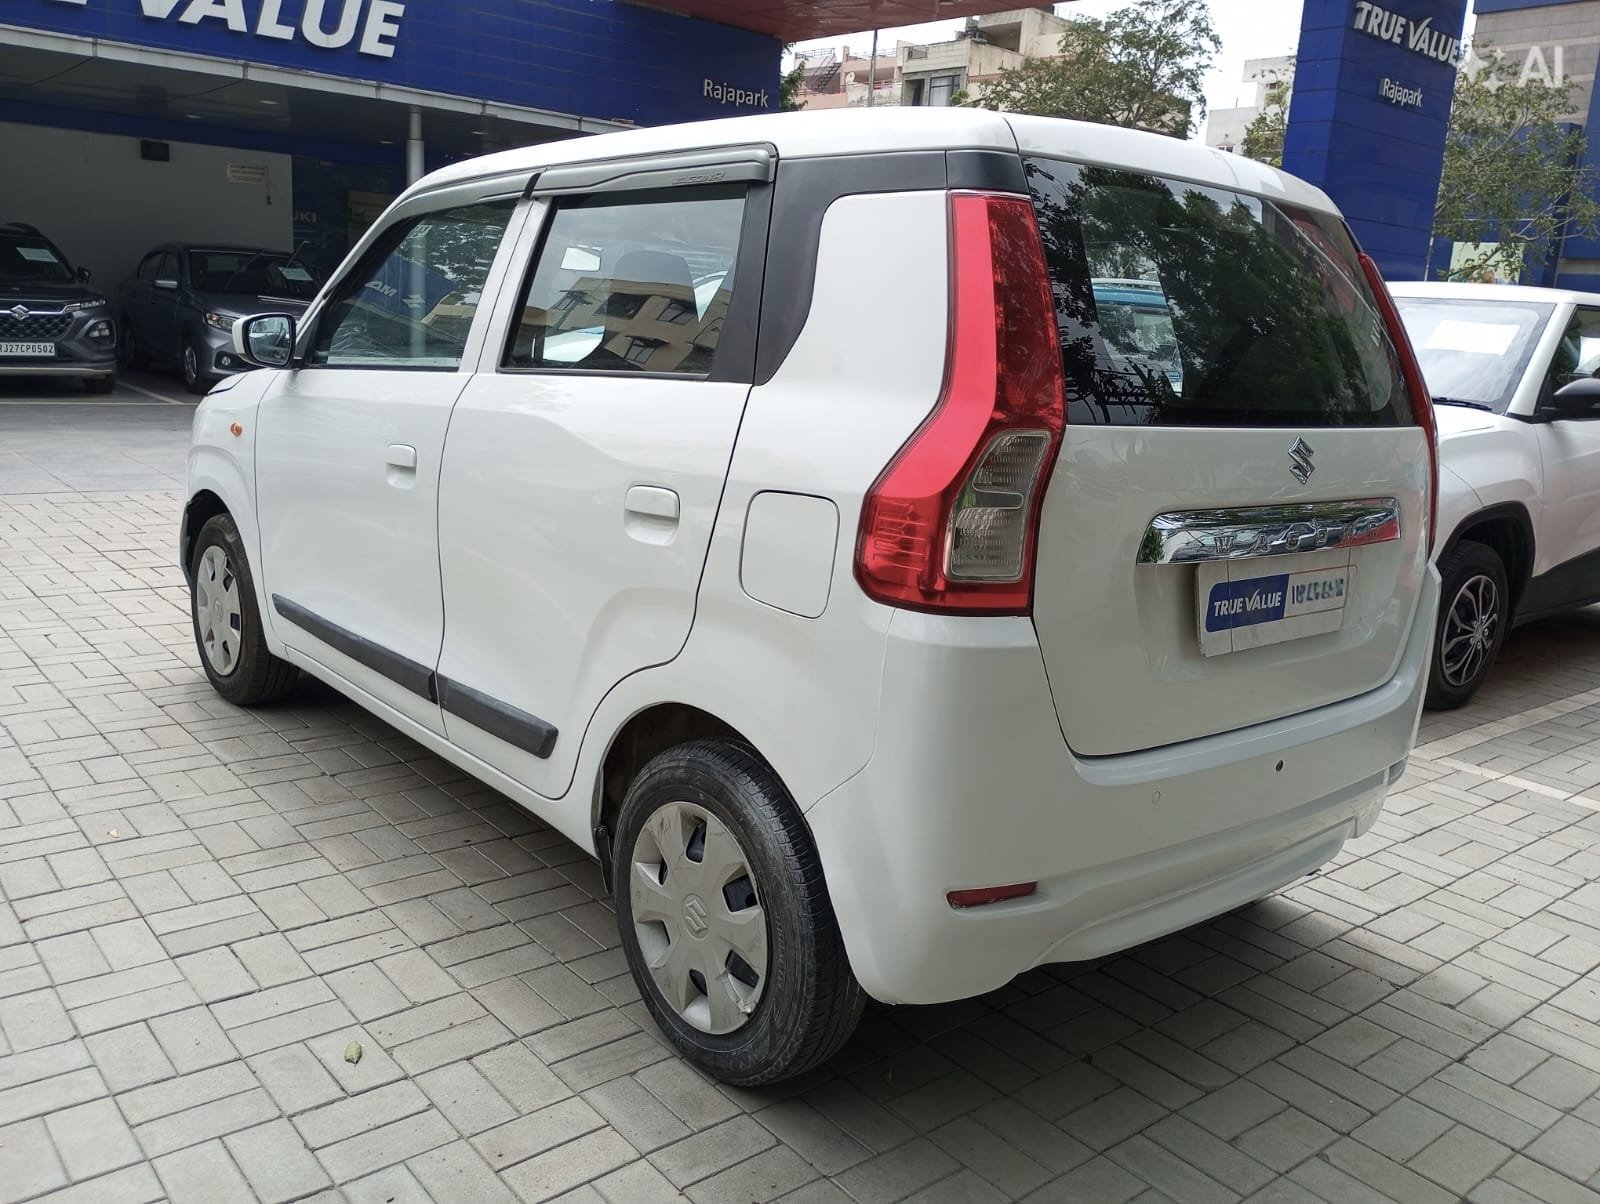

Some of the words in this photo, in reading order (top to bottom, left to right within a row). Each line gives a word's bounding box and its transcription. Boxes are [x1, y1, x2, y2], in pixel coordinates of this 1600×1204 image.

[139, 0, 405, 58] ALUE
[1354, 1, 1407, 44] TRUE
[1408, 17, 1461, 68] VALUE
[703, 79, 769, 108] Rajapark
[1382, 78, 1423, 107] Rajapark
[1214, 597, 1244, 617] TRUE
[1245, 588, 1282, 611] VALUE
